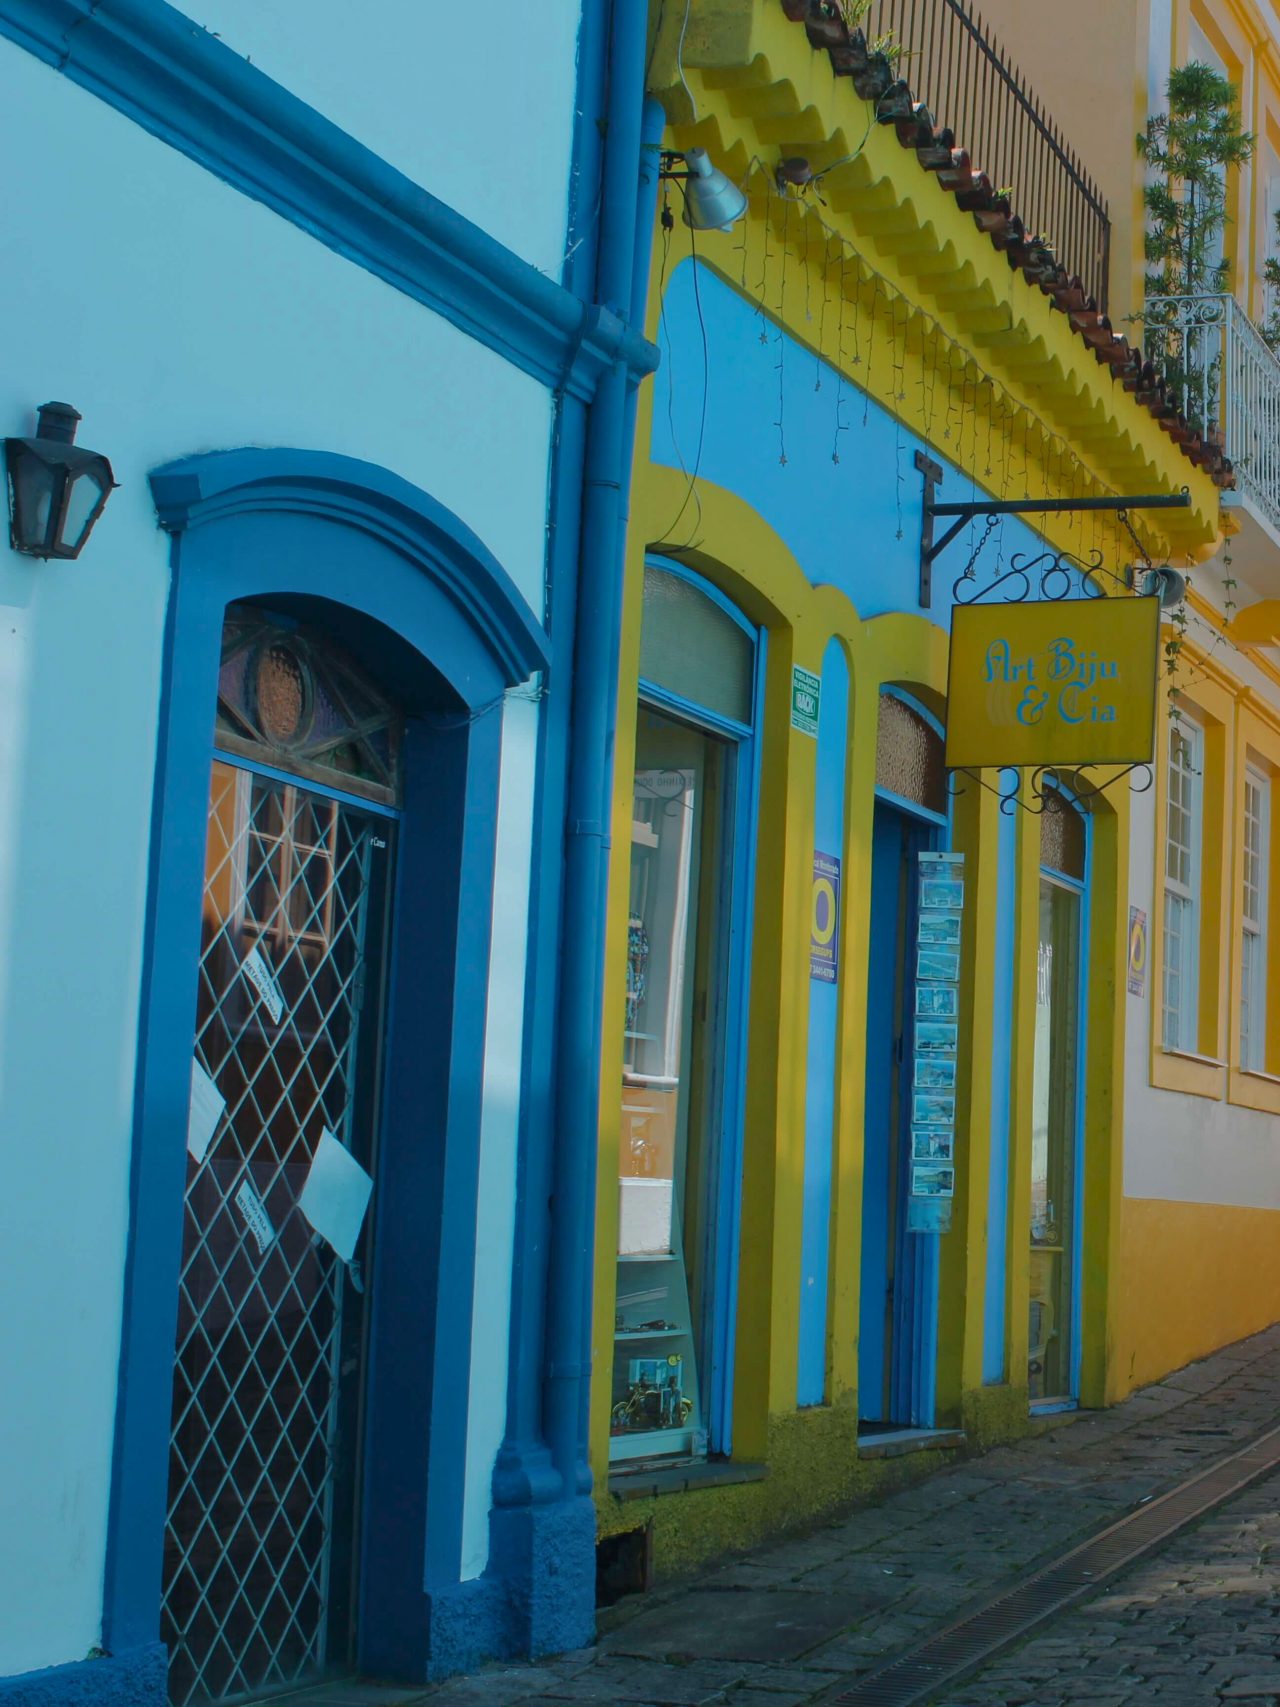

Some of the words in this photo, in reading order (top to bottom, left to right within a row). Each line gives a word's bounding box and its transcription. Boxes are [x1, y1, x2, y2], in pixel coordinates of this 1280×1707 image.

[982, 639, 1039, 683] Art
[1048, 637, 1119, 687] Biju
[1016, 685, 1050, 726] &
[1057, 681, 1117, 725] Cia
